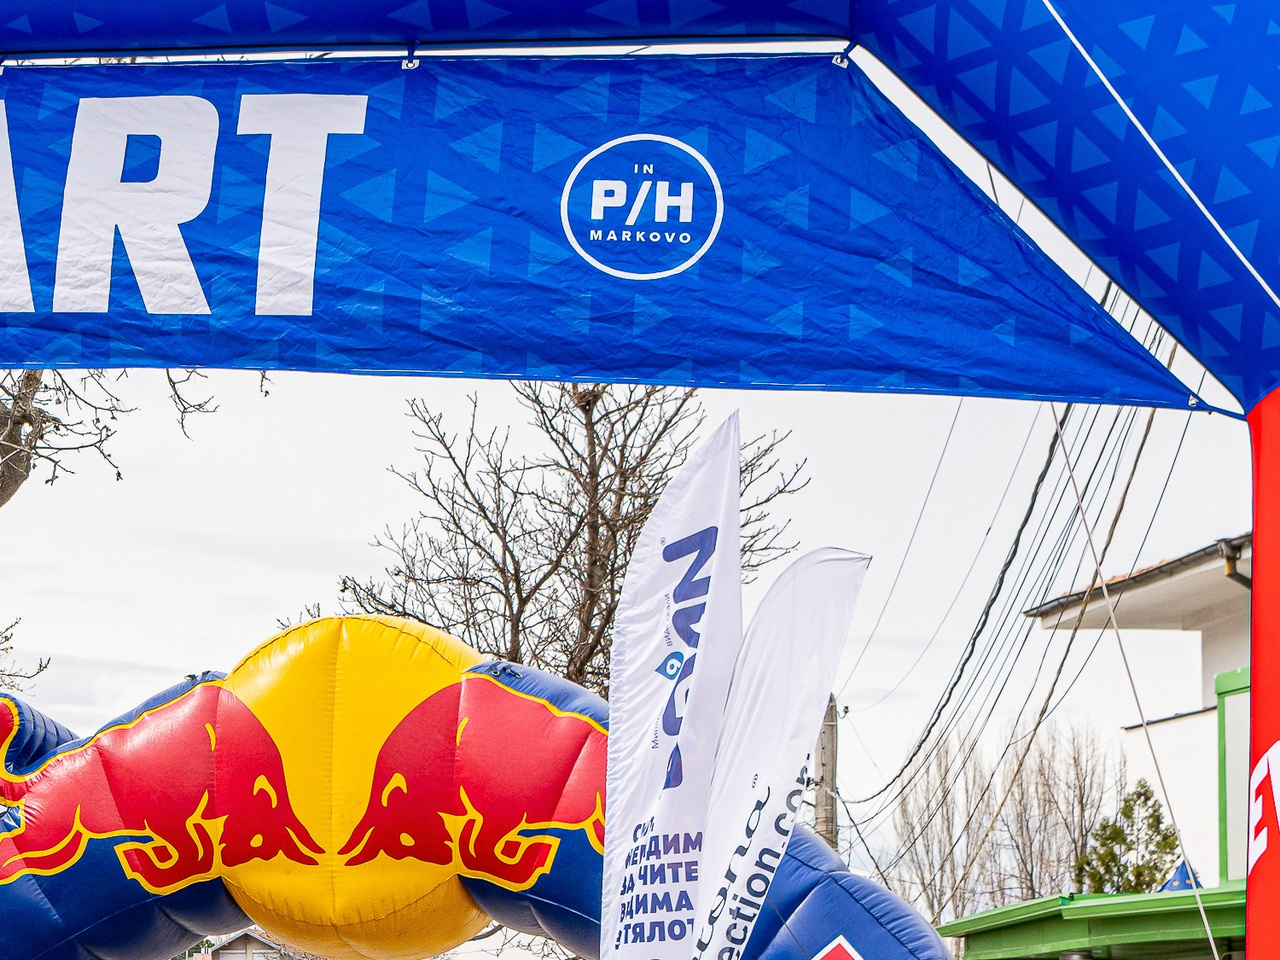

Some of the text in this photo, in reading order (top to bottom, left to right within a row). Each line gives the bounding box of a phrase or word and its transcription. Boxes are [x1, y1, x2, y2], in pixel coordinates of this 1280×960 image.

[634, 164, 654, 174] IN
[591, 179, 694, 226] P/H
[589, 229, 691, 244] MARKOVO
